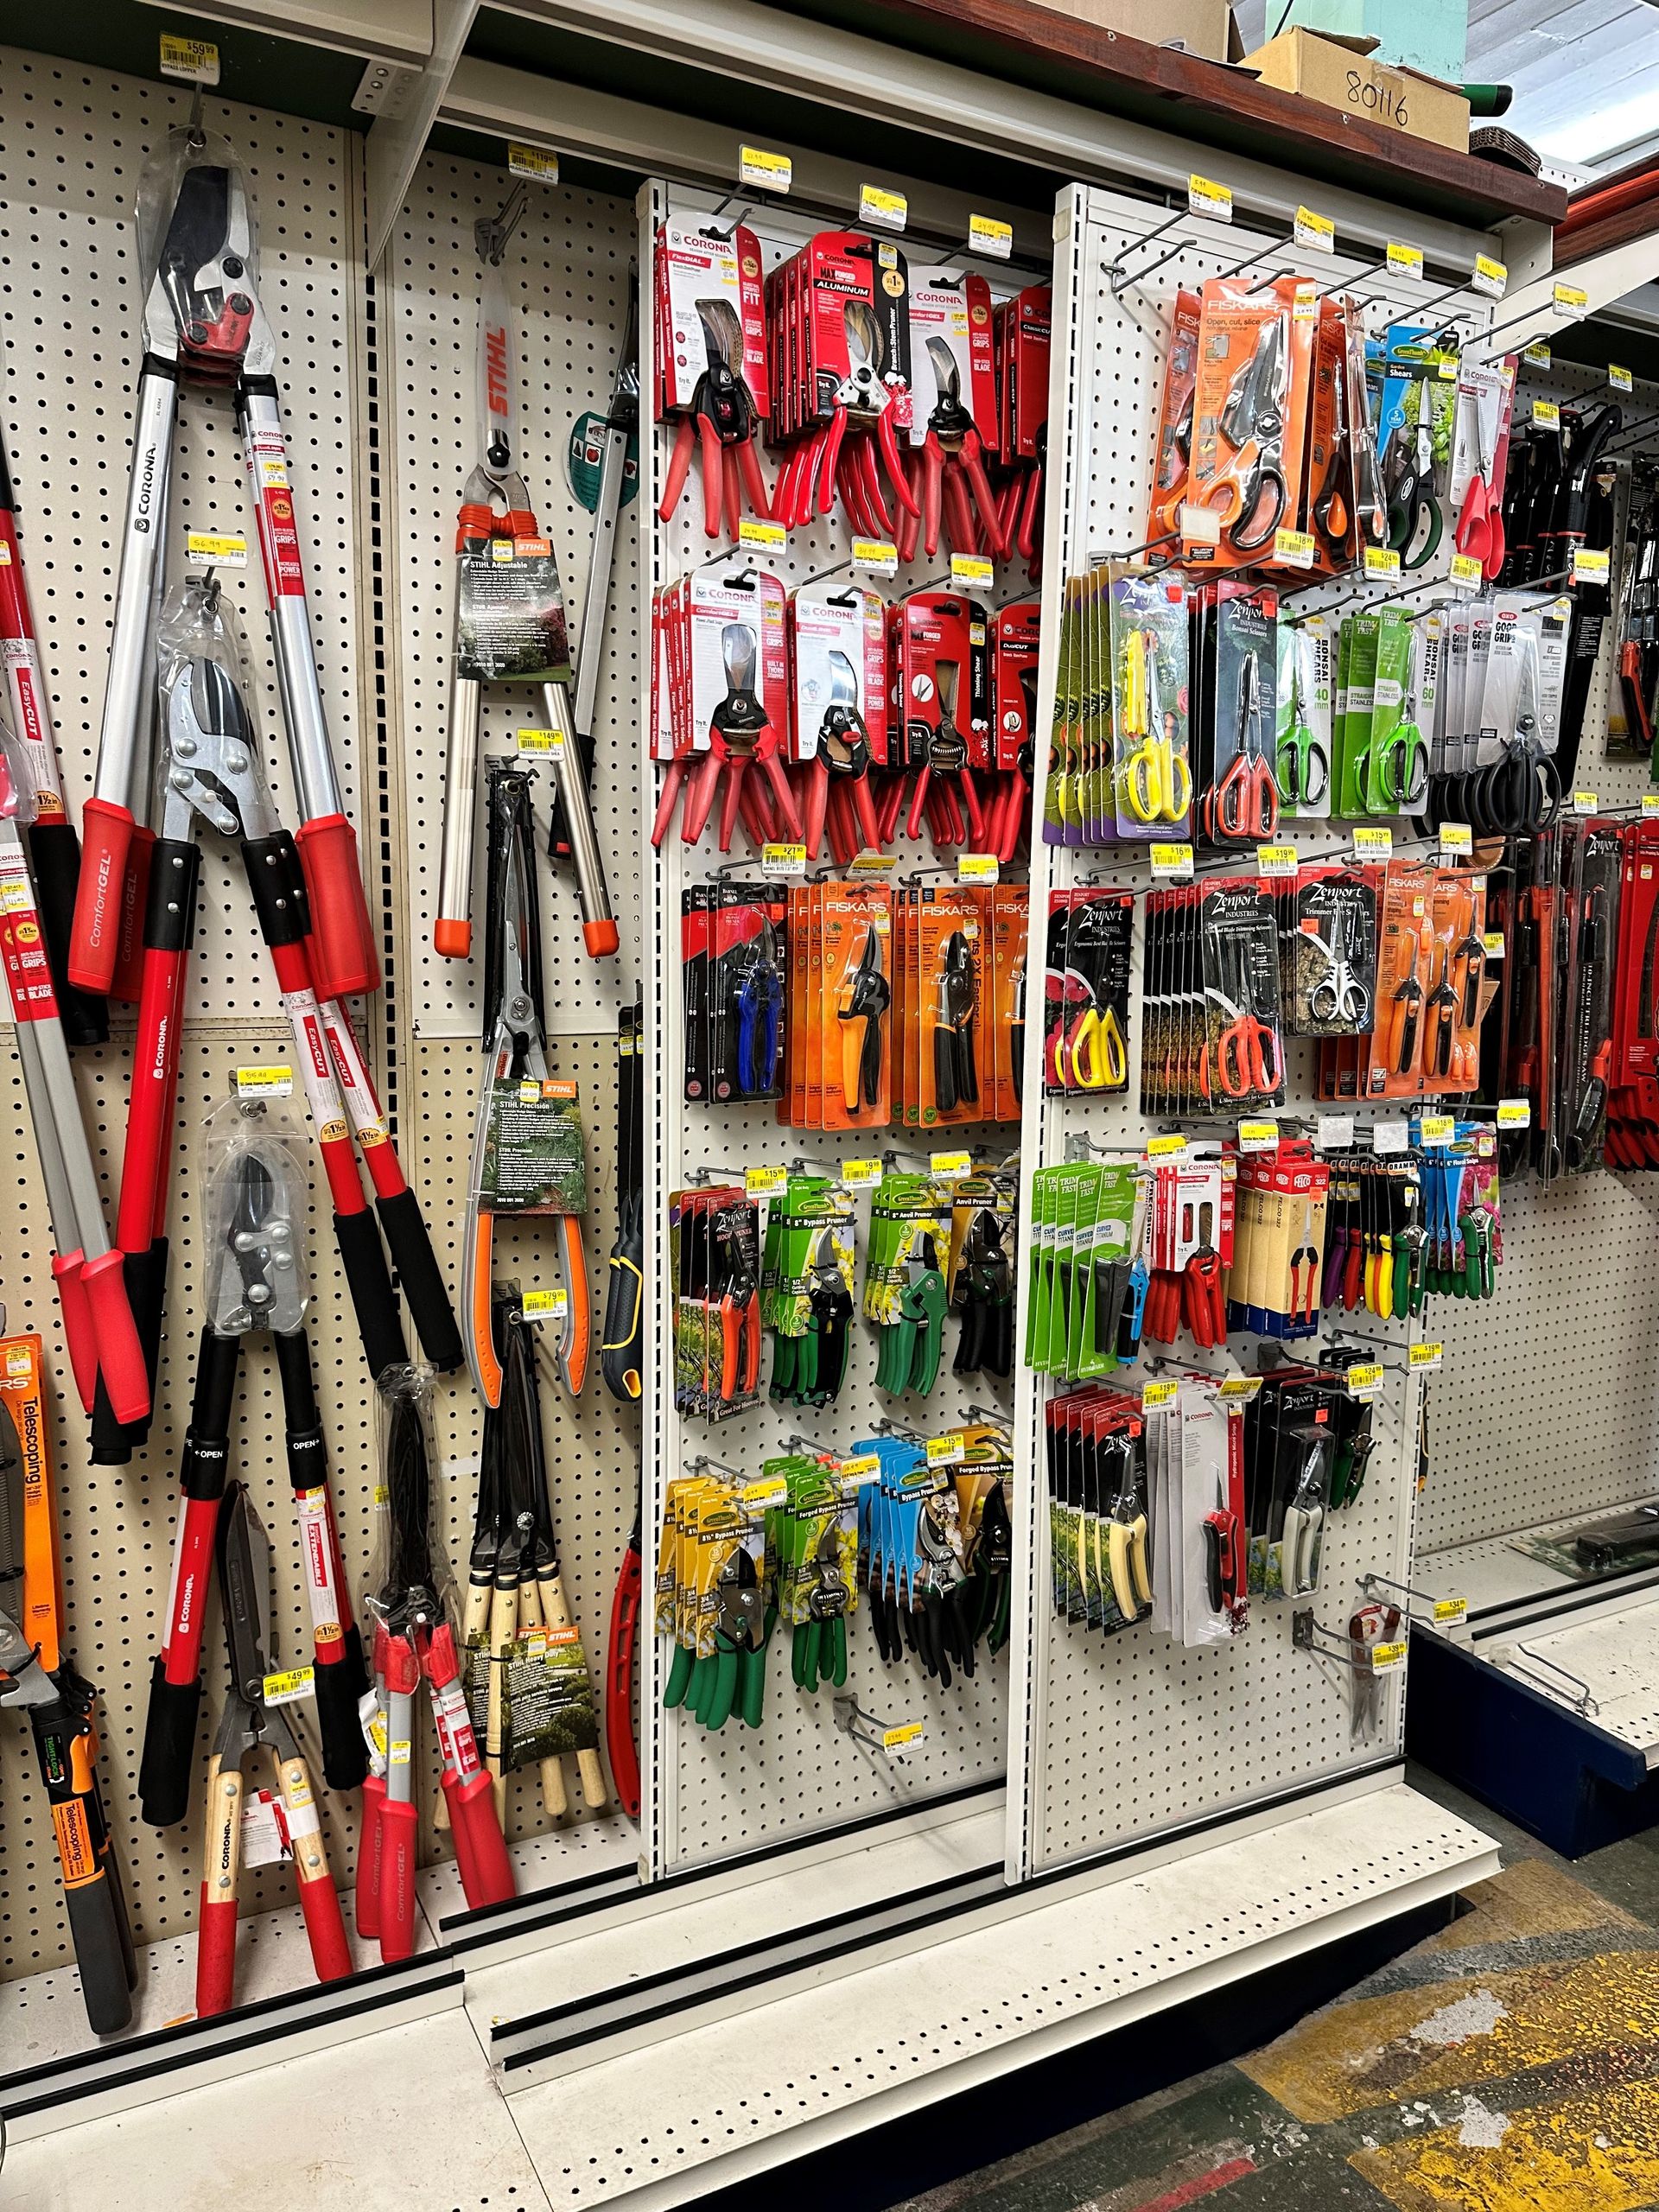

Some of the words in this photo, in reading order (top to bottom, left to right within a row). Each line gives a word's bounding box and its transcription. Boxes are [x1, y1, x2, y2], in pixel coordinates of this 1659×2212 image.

[1346, 70, 1409, 126] 80116
[683, 236, 734, 255] CORONA
[671, 252, 704, 265] FlexDIAL
[824, 254, 855, 265] CORONA
[817, 280, 869, 296] ALUMINUM
[742, 292, 760, 306] FIT
[916, 292, 963, 305] CORONA
[1207, 299, 1281, 312] FISKARS
[1207, 318, 1227, 327] Open,
[1229, 318, 1243, 327] cut,
[972, 339, 990, 349] GRIPS
[1395, 347, 1427, 357] GreenThumb
[486, 327, 508, 417] STIHL
[973, 363, 991, 373] BLADE
[1389, 370, 1413, 378] Shears
[137, 446, 156, 515] CORONA
[276, 535, 296, 544] GRIPS
[279, 566, 301, 575] POWER
[470, 561, 491, 569] STIHL
[492, 561, 528, 571] Adjustable
[709, 589, 756, 602] CORONA
[812, 607, 857, 620] CORONA
[1382, 610, 1399, 620] TRIM
[1239, 620, 1268, 631] INDUSTRIES
[1356, 620, 1374, 628] TRIM
[1383, 619, 1399, 627] FAST
[1495, 621, 1517, 632] GOOD
[923, 631, 941, 641] FORGED
[1231, 625, 1249, 635] Bonsai
[1249, 628, 1268, 638] Scissors
[1357, 626, 1374, 636] FAST
[766, 638, 784, 647] GRIPS
[1494, 632, 1517, 644] GRIPS
[868, 654, 884, 664] GRIPS
[1430, 639, 1439, 682] BONSAI
[868, 677, 884, 687] BLADE
[1376, 684, 1399, 694] STRAIGHT
[1421, 688, 1434, 700] 60
[1313, 689, 1329, 701] 40
[1376, 690, 1400, 701] STAINLESS
[21, 680, 38, 736] EasyCUT
[868, 698, 885, 709] POWER
[1314, 702, 1329, 710] mm
[1586, 833, 1620, 858] Zenport
[1388, 878, 1426, 889] FISKARS
[1309, 883, 1363, 905] Zenport
[89, 853, 112, 948] ComfortGEL
[1211, 892, 1262, 917] Zenport
[826, 901, 887, 913] FISKARS
[922, 906, 979, 917] FISKARS
[995, 903, 1029, 914] FISKA
[1305, 907, 1332, 917] Trimmer
[1078, 905, 1123, 929] Zenport
[1224, 909, 1260, 918] INDUSTRIES
[22, 957, 47, 969] GRIPS
[29, 989, 54, 1000] BLADE
[156, 1017, 168, 1068] CORONA
[308, 1027, 326, 1074] EasyCUT
[330, 1039, 352, 1084] EasyCUT
[545, 1084, 573, 1095] STIHL
[499, 1101, 518, 1109] STIHL
[519, 1101, 550, 1110] Precision
[1389, 1160, 1417, 1172] DRAMM
[1103, 1171, 1117, 1180] TRIM
[1294, 1173, 1313, 1187] FELCO
[959, 1182, 989, 1192] GreenThumb
[1103, 1179, 1116, 1189] FAST
[1080, 1187, 1095, 1197] FAST
[897, 1195, 927, 1204] GreenThumb
[969, 1198, 994, 1206] Pruner
[801, 1202, 831, 1211] GreenThumb
[1146, 1179, 1155, 1244] PRECISION
[914, 1211, 933, 1219] Pruner
[716, 1208, 753, 1234] Zenport
[804, 1218, 826, 1229] Bypass
[826, 1216, 848, 1225] Pruner
[1096, 1224, 1112, 1234] CURVED
[1076, 1231, 1093, 1241] CURVED
[1095, 1230, 1114, 1240] TITANIUM
[1190, 1411, 1214, 1421] CORONA
[22, 1396, 42, 1484] Telescoping
[293, 1440, 315, 1450] OPEN
[200, 1450, 223, 1459] OPEN
[959, 1465, 977, 1474] Forged
[977, 1464, 999, 1473] Bypass
[802, 1491, 830, 1503] GreenThumb
[901, 1492, 919, 1503] Bypass
[798, 1507, 817, 1519] Forged
[817, 1503, 836, 1516] Bypass
[836, 1500, 857, 1510] Pruner
[706, 1513, 735, 1524] GreenThumb
[309, 1526, 322, 1586] EXTENDABLE
[181, 1576, 194, 1623] CORONA
[549, 1630, 576, 1642] STIHL
[508, 1659, 525, 1671] STIHL
[525, 1655, 544, 1665] Heavy
[544, 1650, 561, 1660] Duty
[66, 1803, 82, 1862] Telescoping
[221, 1821, 232, 1870] CORONA
[397, 1847, 405, 1923] ComfortGEL
